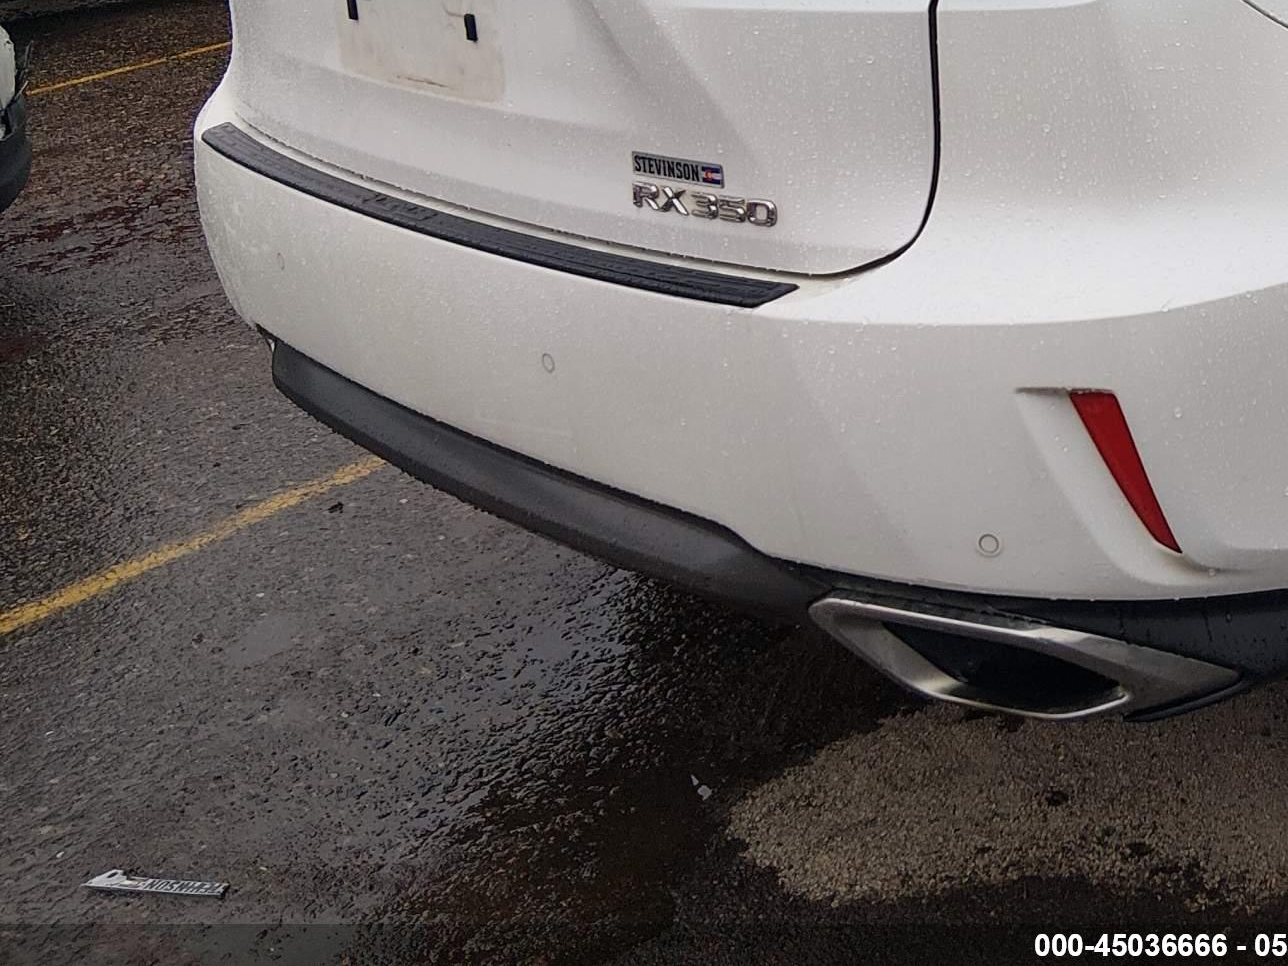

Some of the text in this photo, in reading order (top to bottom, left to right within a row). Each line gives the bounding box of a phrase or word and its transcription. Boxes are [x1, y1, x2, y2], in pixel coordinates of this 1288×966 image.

[633, 154, 700, 182] STEVINSON
[632, 181, 778, 227] RX 350
